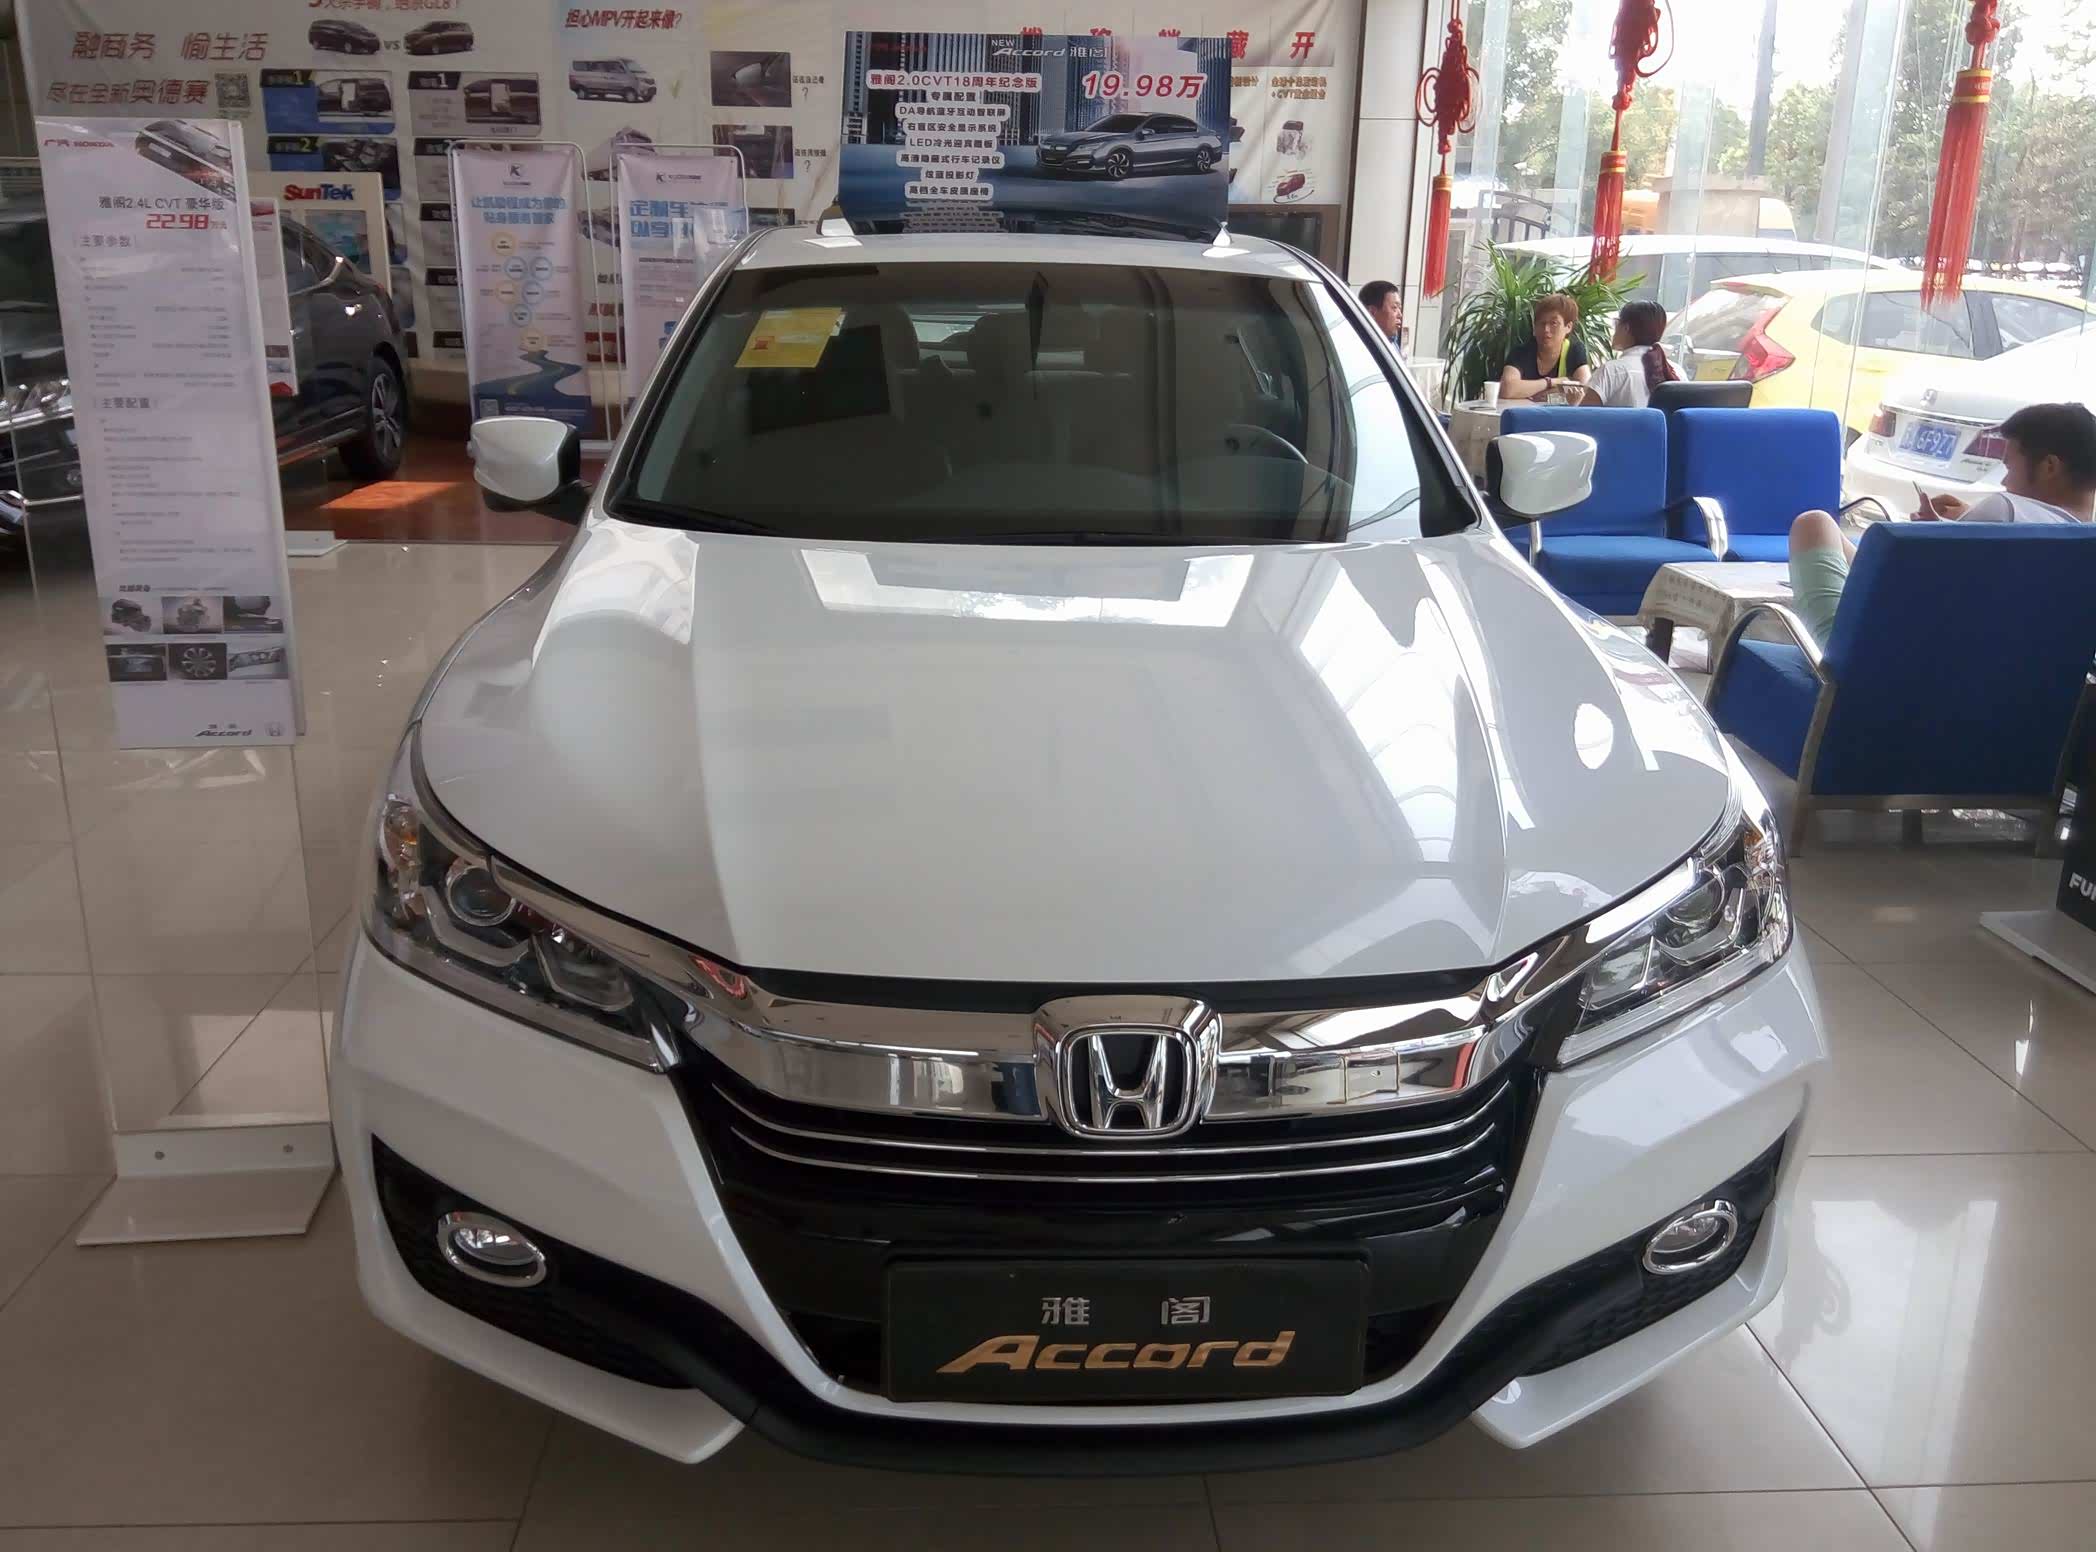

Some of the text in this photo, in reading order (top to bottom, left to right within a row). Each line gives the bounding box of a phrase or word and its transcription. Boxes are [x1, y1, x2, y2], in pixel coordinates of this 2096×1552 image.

[71, 32, 269, 61] 融商务 愉生活
[991, 39, 1016, 47] NEW
[991, 47, 1067, 57] Accord
[869, 73, 1039, 89] 雅阁2.0CVT18周年纪念版
[1084, 72, 1204, 99] 19.98万
[46, 80, 211, 105] 尽在全新奥德赛
[284, 184, 355, 201] SunTek
[99, 196, 152, 209] 雅阁2.4L
[154, 197, 181, 209] CVT
[935, 1330, 1297, 1374] Accord
